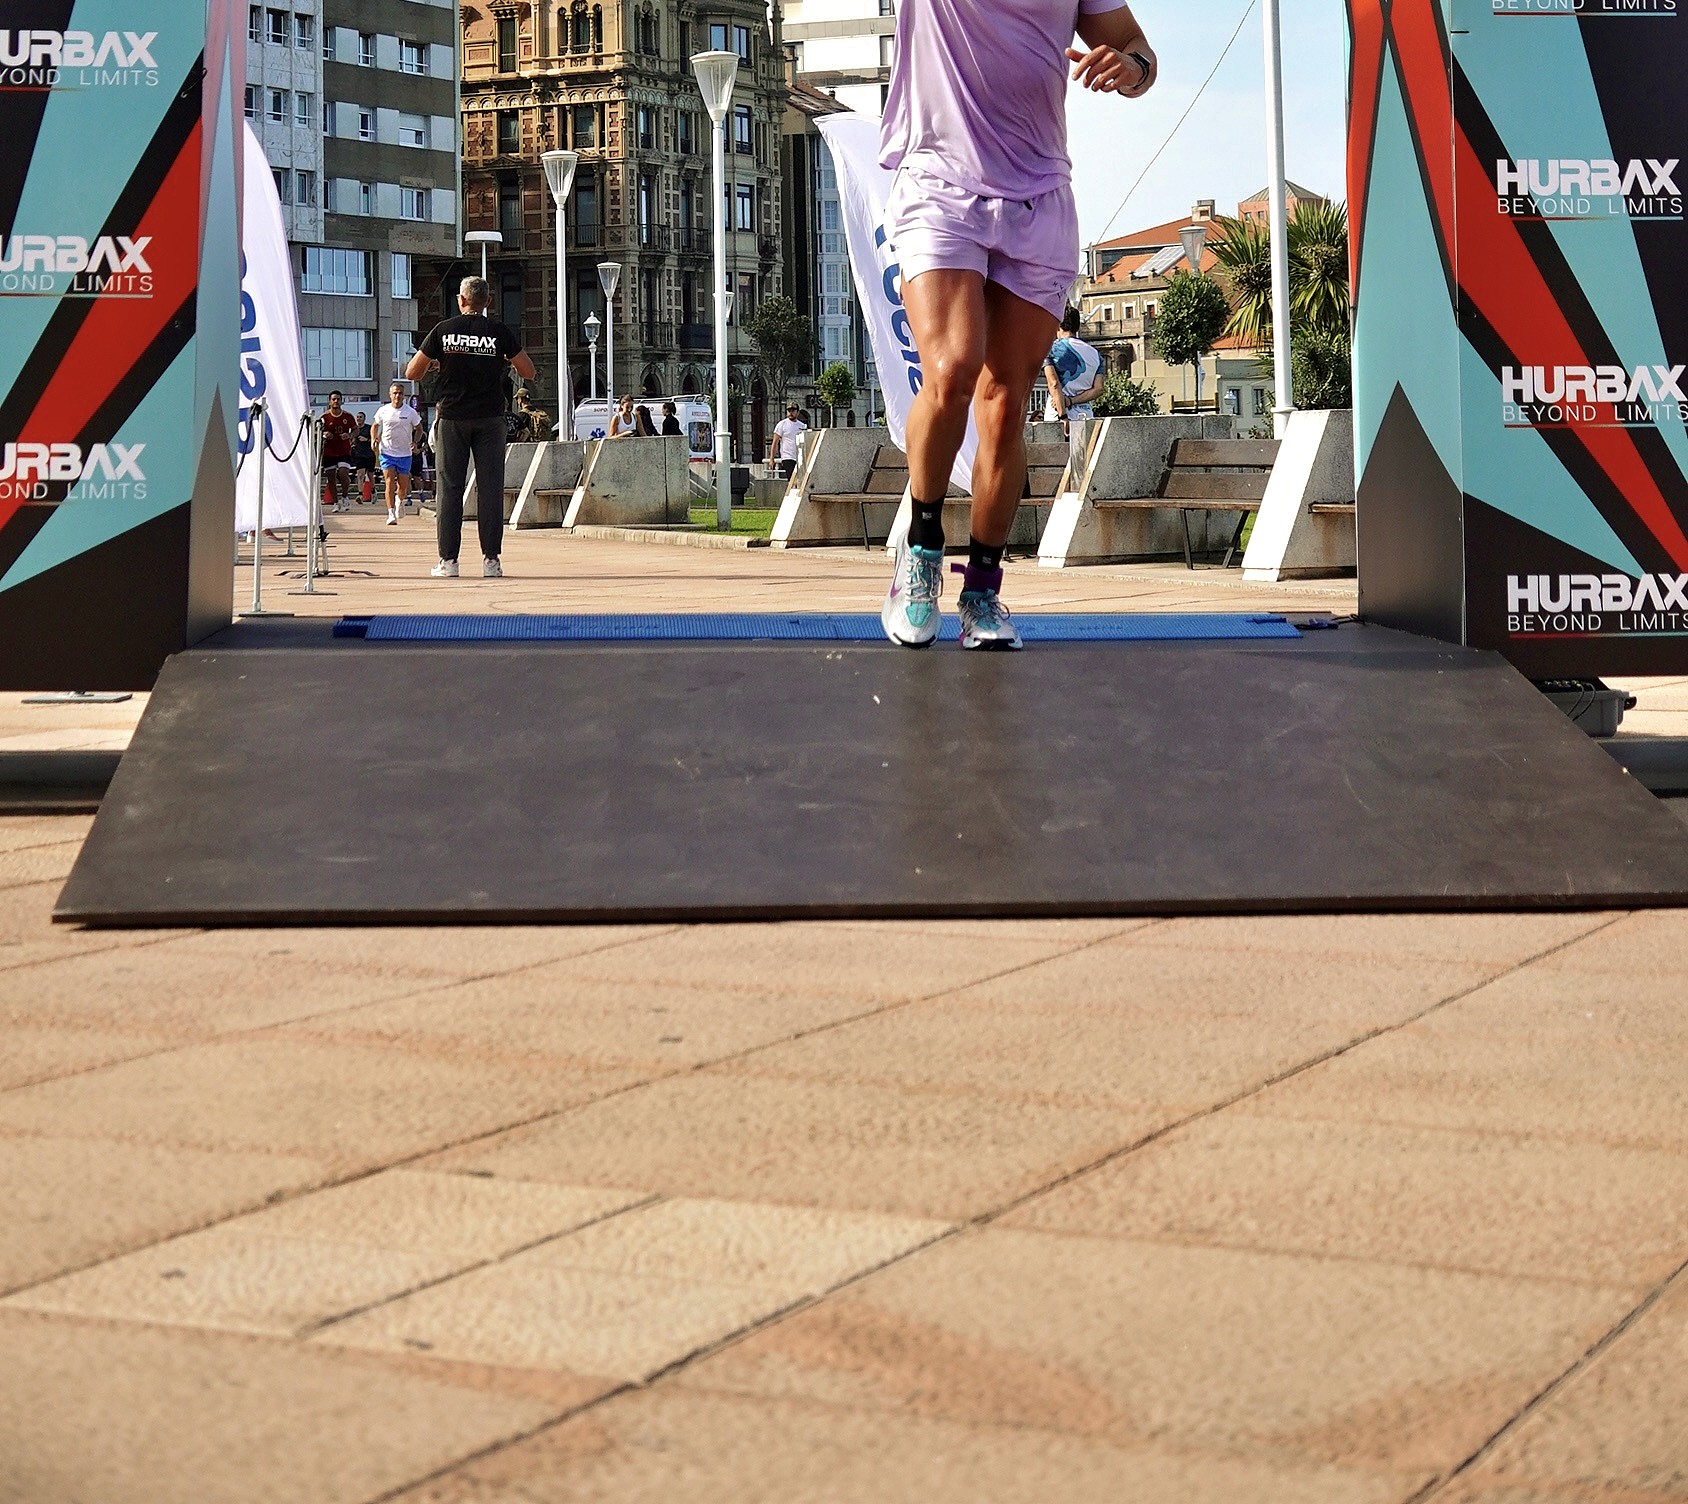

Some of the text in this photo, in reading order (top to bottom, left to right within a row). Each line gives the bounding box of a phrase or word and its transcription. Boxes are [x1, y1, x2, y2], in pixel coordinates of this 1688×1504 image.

[0, 29, 159, 68] URBAX
[0, 68, 160, 86] YOND LIMITS
[1496, 159, 1681, 196] HURBAX
[1497, 198, 1684, 215] BEYOND LIMITS
[0, 234, 153, 273] URBAX
[2, 273, 154, 292] OND LIMITS
[442, 334, 497, 349] HURBAX
[443, 345, 497, 355] BEYOND LIMITS
[1502, 365, 1688, 403] HURBAX
[1502, 404, 1688, 422] BEYOND LIMITS
[0, 481, 148, 500] OND LIMITS
[1507, 573, 1688, 613] HURBAX
[1507, 614, 1601, 632] BEYOND
